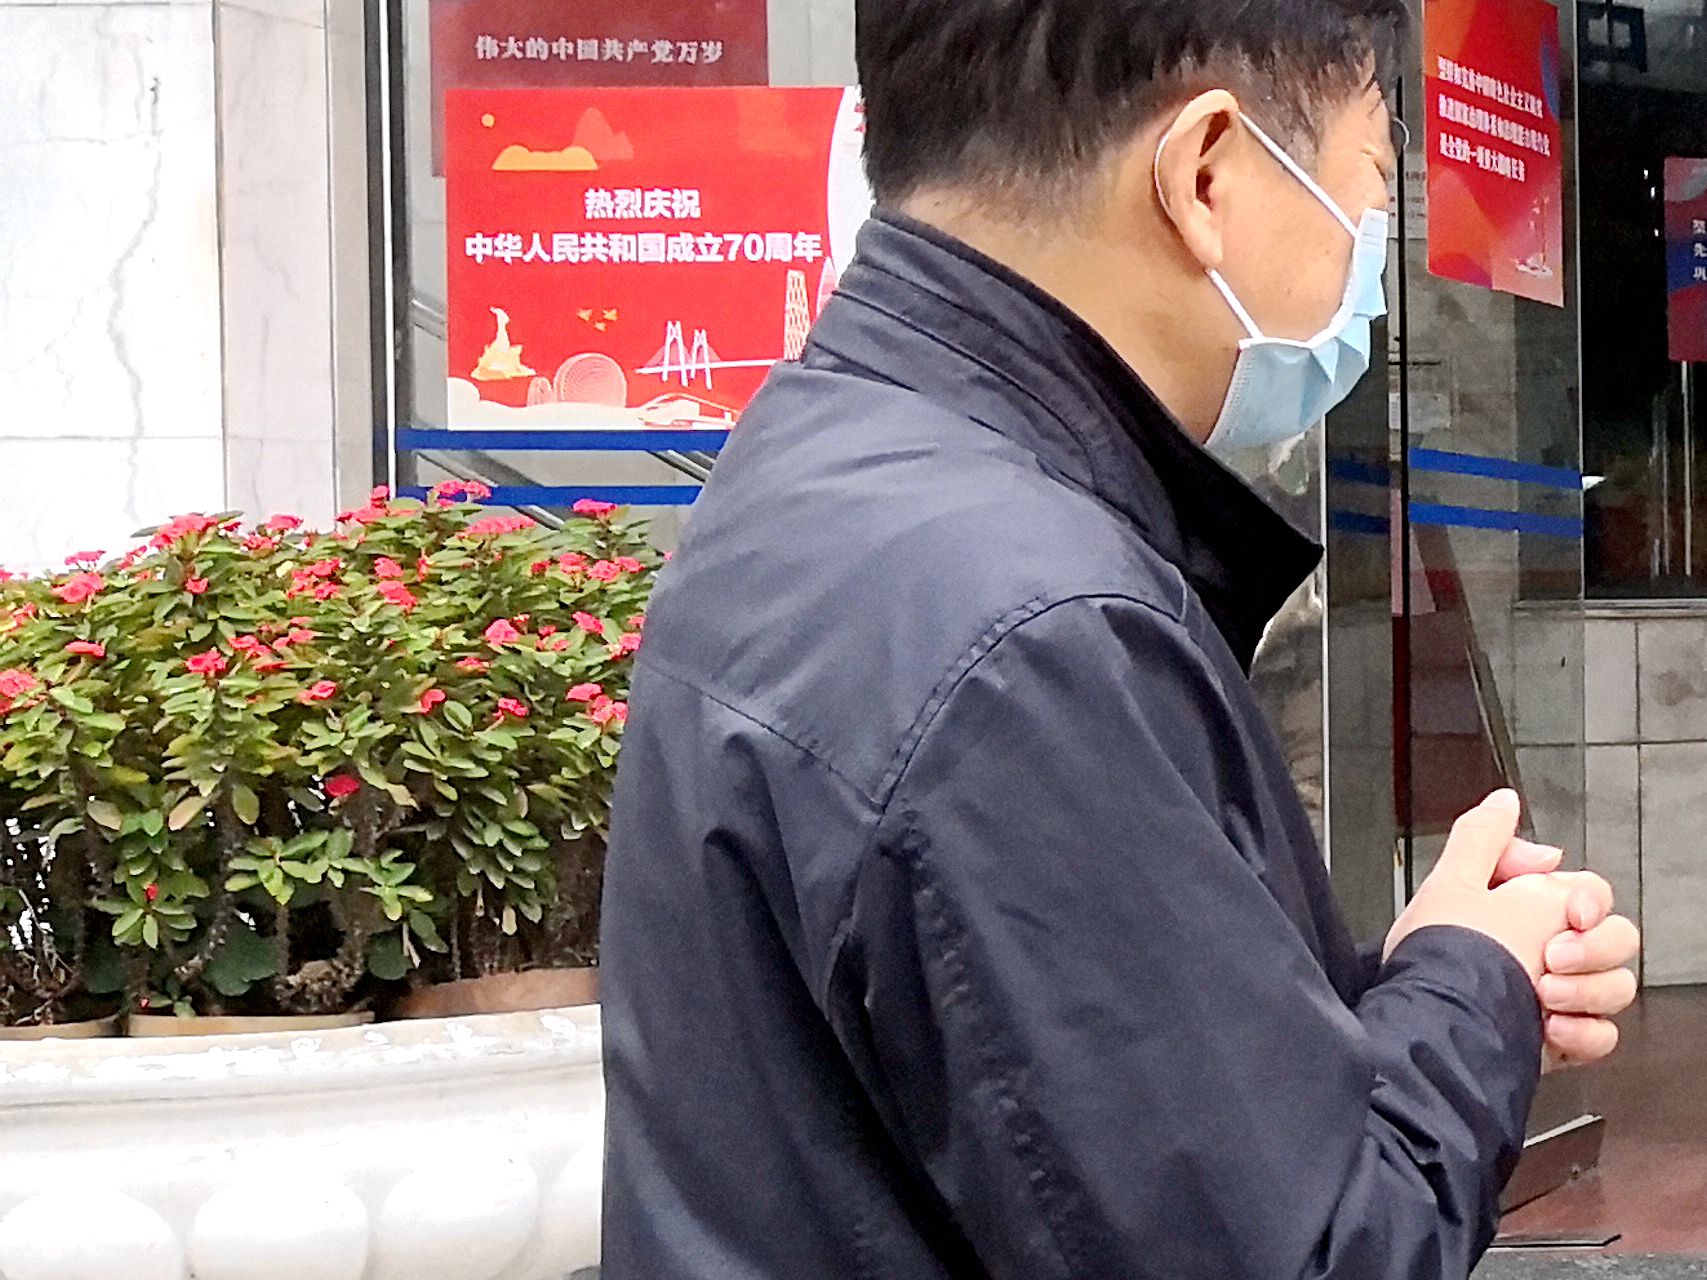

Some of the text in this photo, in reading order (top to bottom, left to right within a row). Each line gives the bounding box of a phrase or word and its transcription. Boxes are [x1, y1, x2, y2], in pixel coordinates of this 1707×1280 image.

[474, 34, 724, 65] 伟大的中国共产党万岁
[584, 188, 702, 220] 热烈庆祝
[465, 231, 824, 265] 中华人民共和国成立70周年
